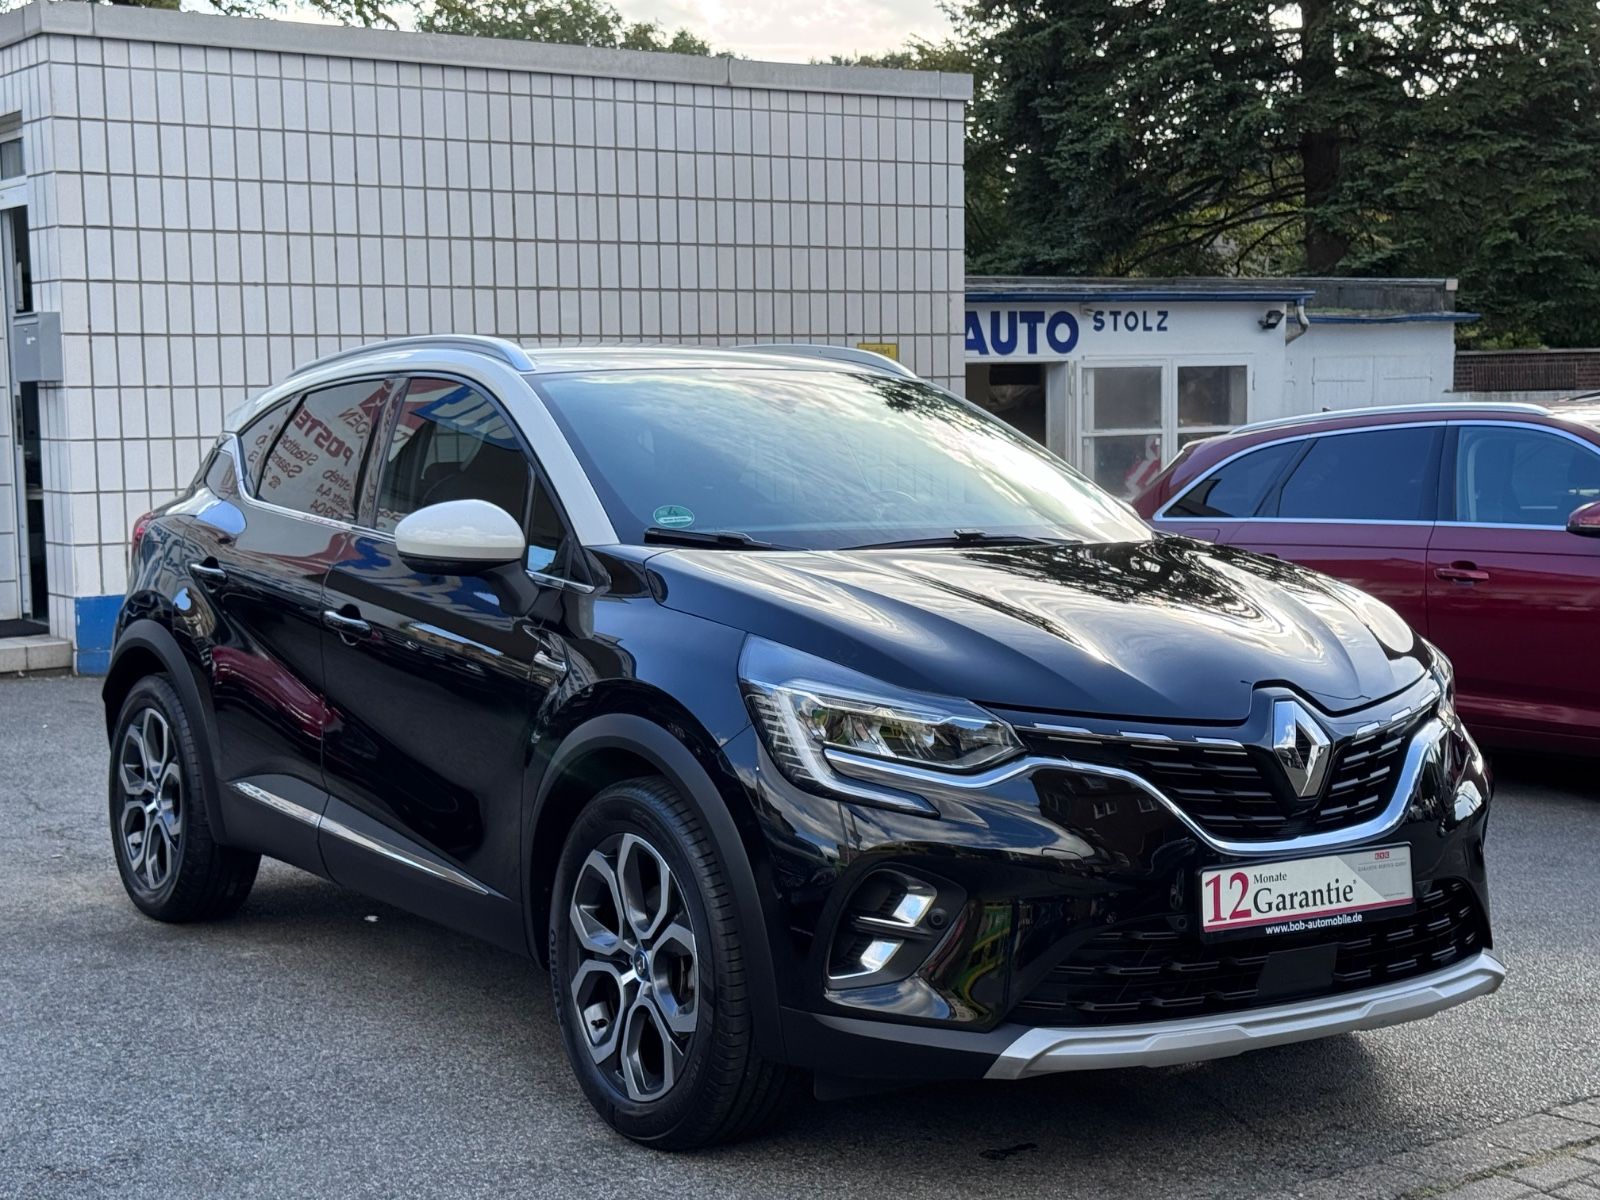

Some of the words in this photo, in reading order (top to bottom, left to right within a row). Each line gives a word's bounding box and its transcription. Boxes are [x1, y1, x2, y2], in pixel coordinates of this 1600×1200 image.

[965, 311, 1079, 355] AUTO
[1093, 310, 1169, 332] STOLZ
[1253, 872, 1288, 885] Monate
[1205, 871, 1253, 923] 12
[1265, 913, 1363, 935] www.bob-automobile.de
